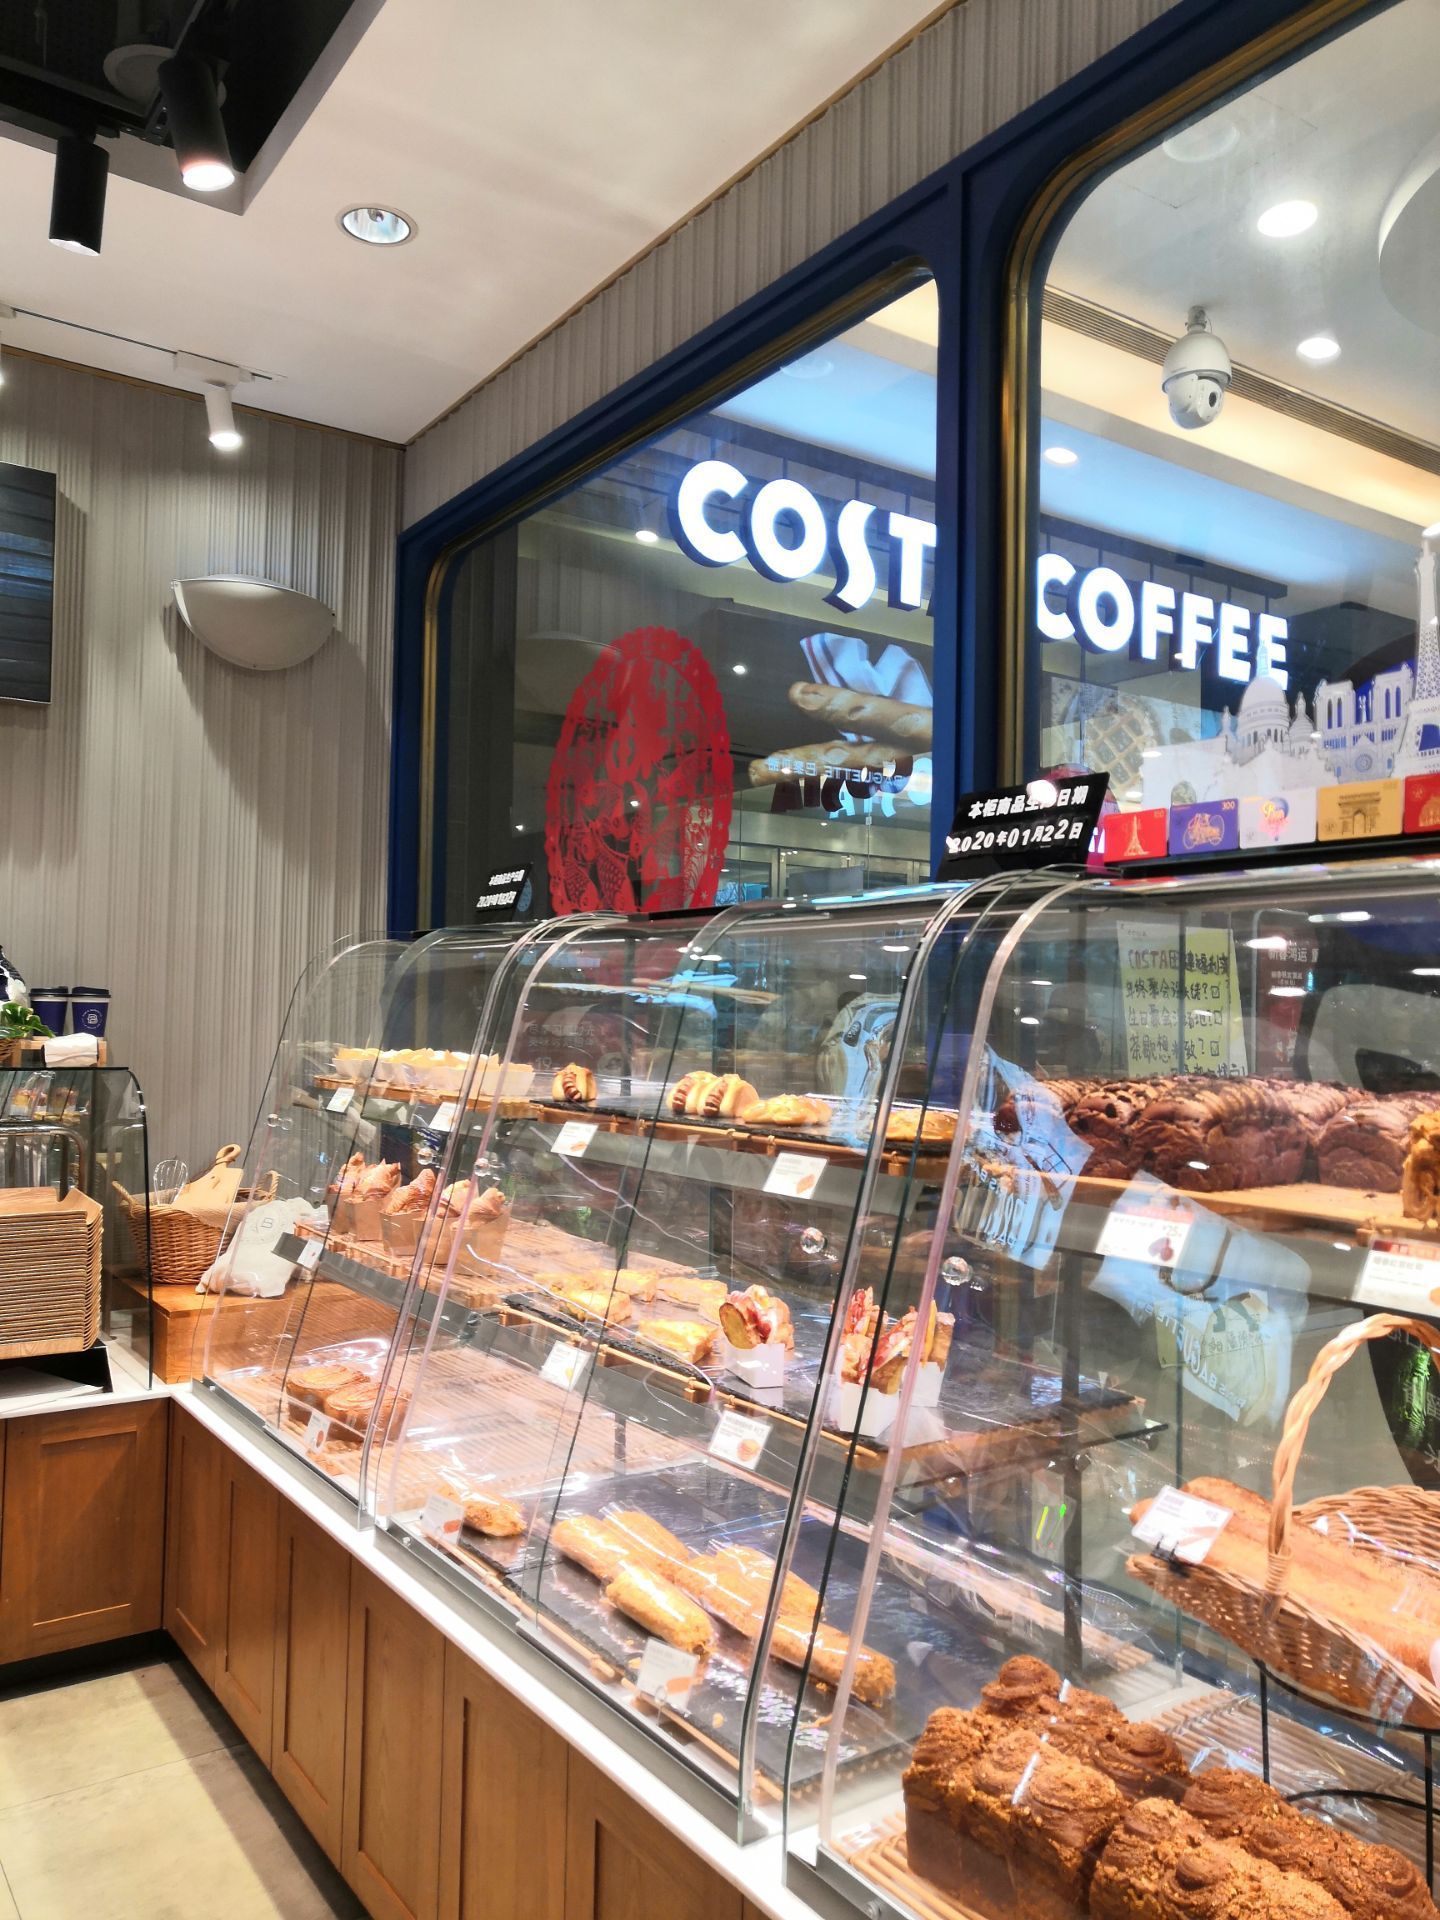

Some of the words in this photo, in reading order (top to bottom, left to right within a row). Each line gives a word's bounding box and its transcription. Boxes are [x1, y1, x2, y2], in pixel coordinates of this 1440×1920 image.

[676, 459, 937, 612] COST
[1037, 553, 1289, 690] COFFEE
[968, 785, 1090, 820] 本柜商品生日期
